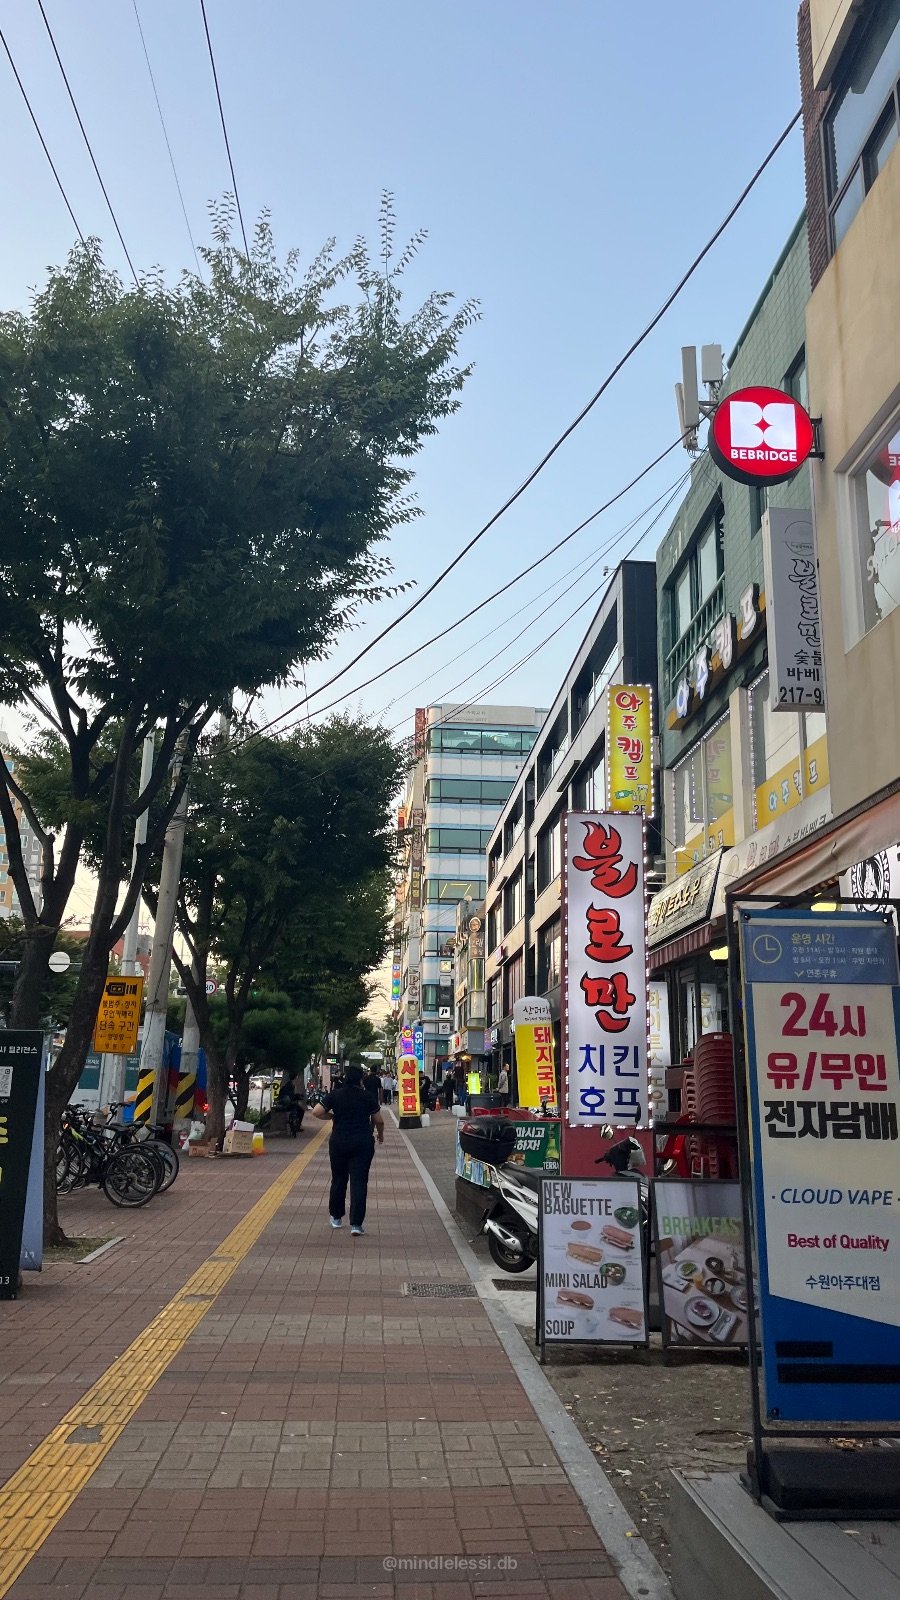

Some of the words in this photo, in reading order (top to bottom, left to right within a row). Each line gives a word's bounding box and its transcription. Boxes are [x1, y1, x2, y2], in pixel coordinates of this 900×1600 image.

[730, 449, 797, 462] BEBRIDGE
[676, 583, 758, 718] 아주캠프
[615, 691, 643, 781] 아주캠프
[815, 933, 835, 944] 시간
[780, 992, 867, 1037] 24시
[99, 1021, 115, 1031] 단속
[118, 1021, 135, 1032] 구간
[414, 1031, 423, 1057] GS25
[533, 1026, 556, 1104] 돼지국밥
[578, 1044, 640, 1077] 치킨
[766, 1052, 888, 1091] 유/무인
[579, 1086, 641, 1118] 호프
[763, 1100, 899, 1141] 전자담배
[543, 1161, 560, 1171] TERRA
[543, 1182, 572, 1199] NEW
[780, 1188, 843, 1205] CLOUD
[848, 1189, 894, 1206] VAPE
[544, 1198, 612, 1216] BAGUETTE
[787, 1233, 820, 1249] Best
[823, 1234, 837, 1249] of
[840, 1234, 890, 1252] Quality
[545, 1272, 570, 1288] MINI
[572, 1273, 609, 1289] SALAD
[805, 1275, 881, 1291] 수원아주대점
[545, 1319, 575, 1336] SOUP
